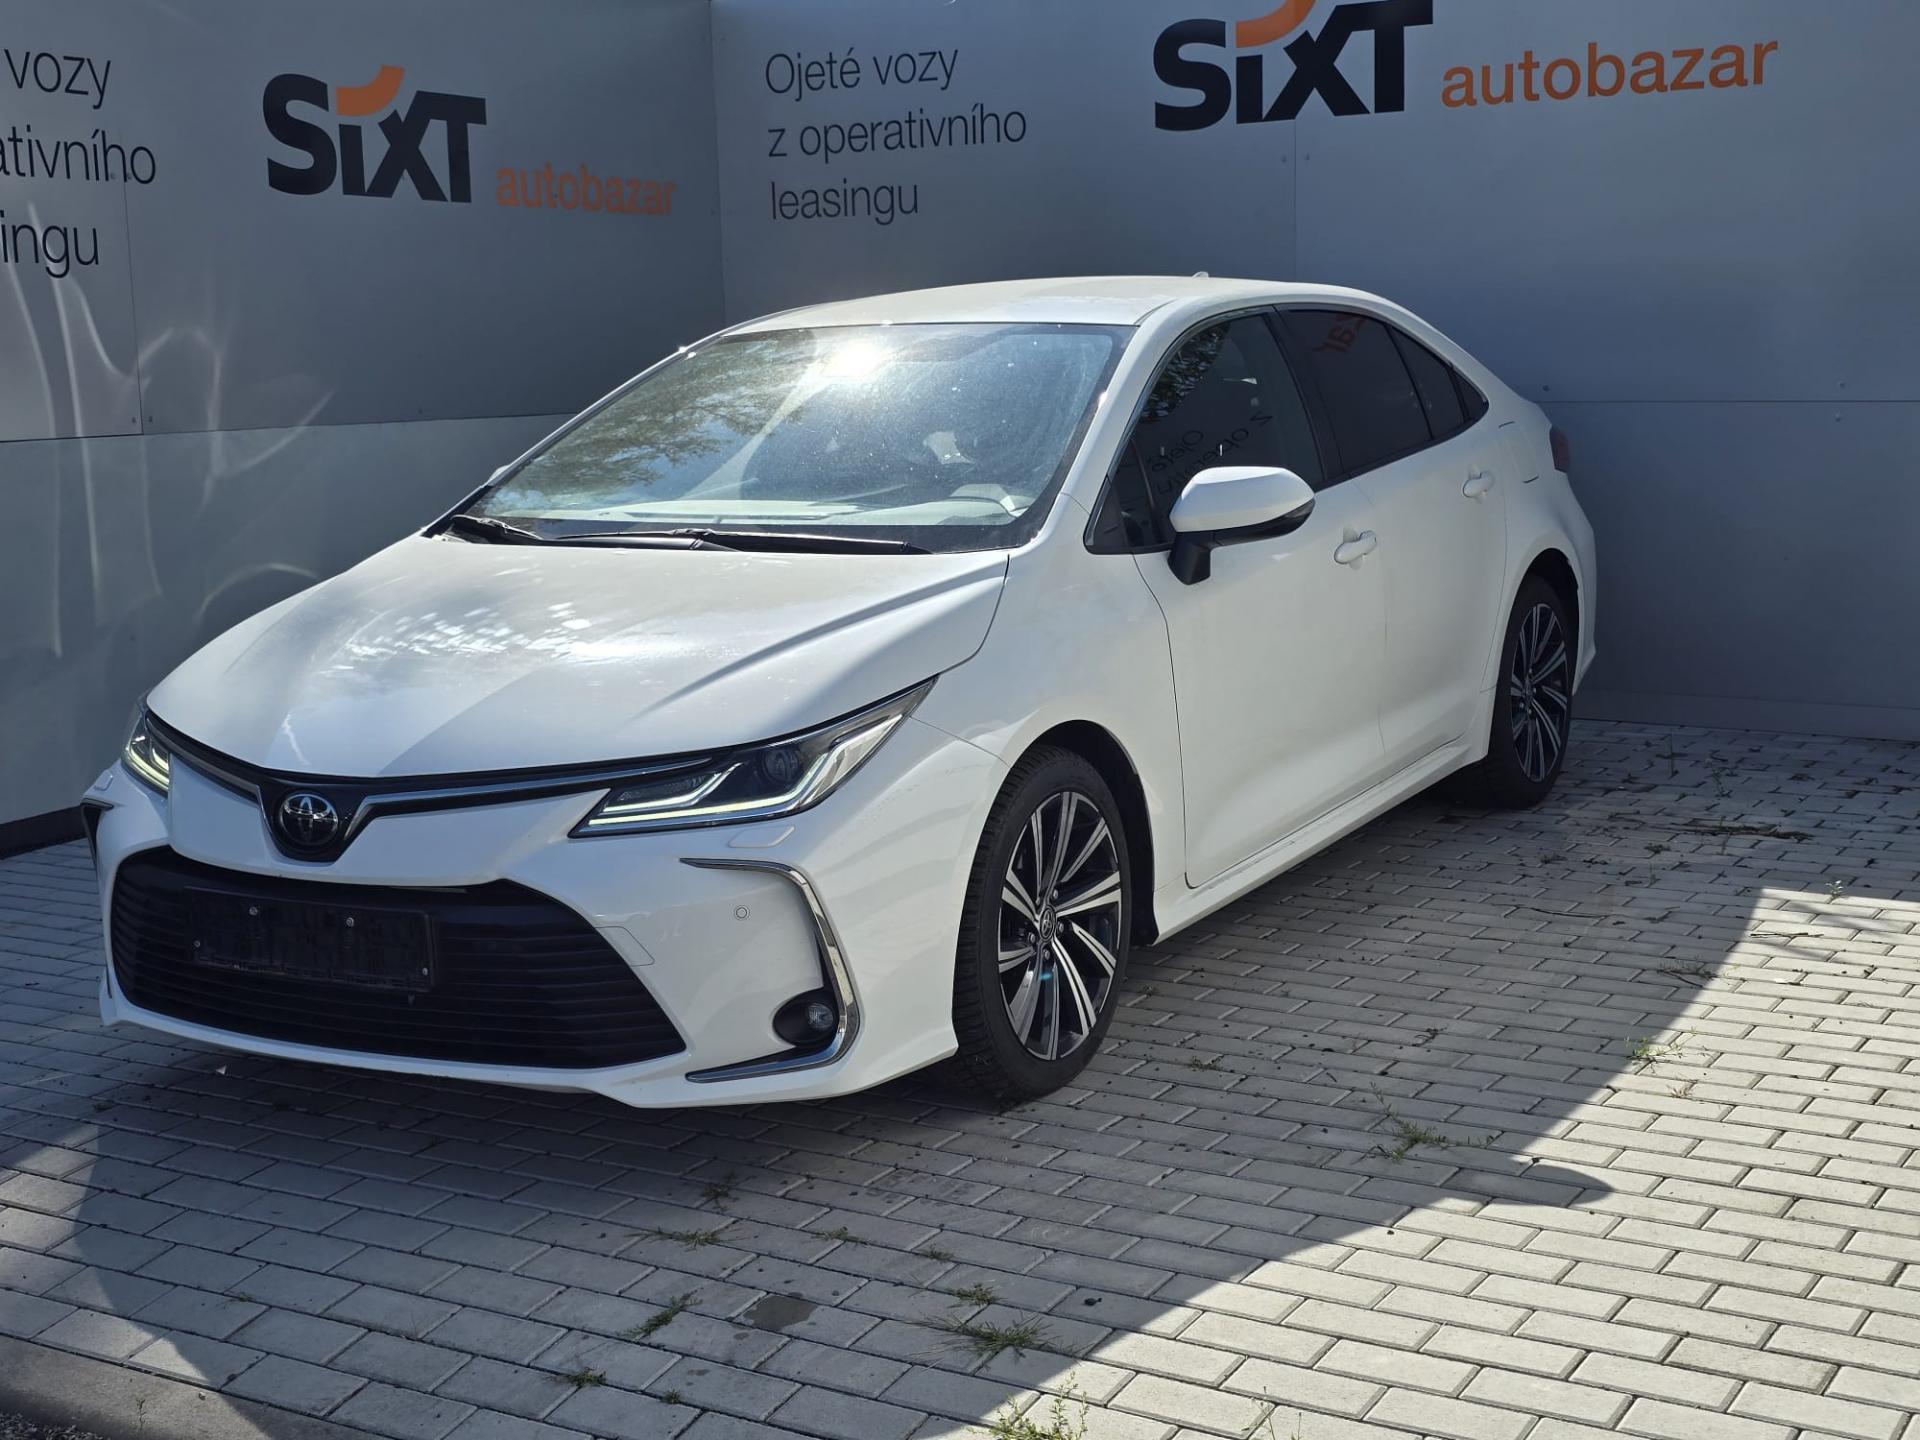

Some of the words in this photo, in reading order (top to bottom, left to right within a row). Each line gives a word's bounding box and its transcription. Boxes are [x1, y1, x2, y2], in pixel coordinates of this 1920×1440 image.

[4, 48, 111, 110] vozy
[765, 47, 861, 102] Ojeté
[872, 49, 959, 91] vozy
[1441, 40, 1778, 108] autobazar
[768, 127, 787, 157] z
[800, 103, 1027, 164] operativního
[496, 161, 678, 216] autobazar
[770, 178, 918, 226] leasingu
[0, 209, 100, 279] ingu
